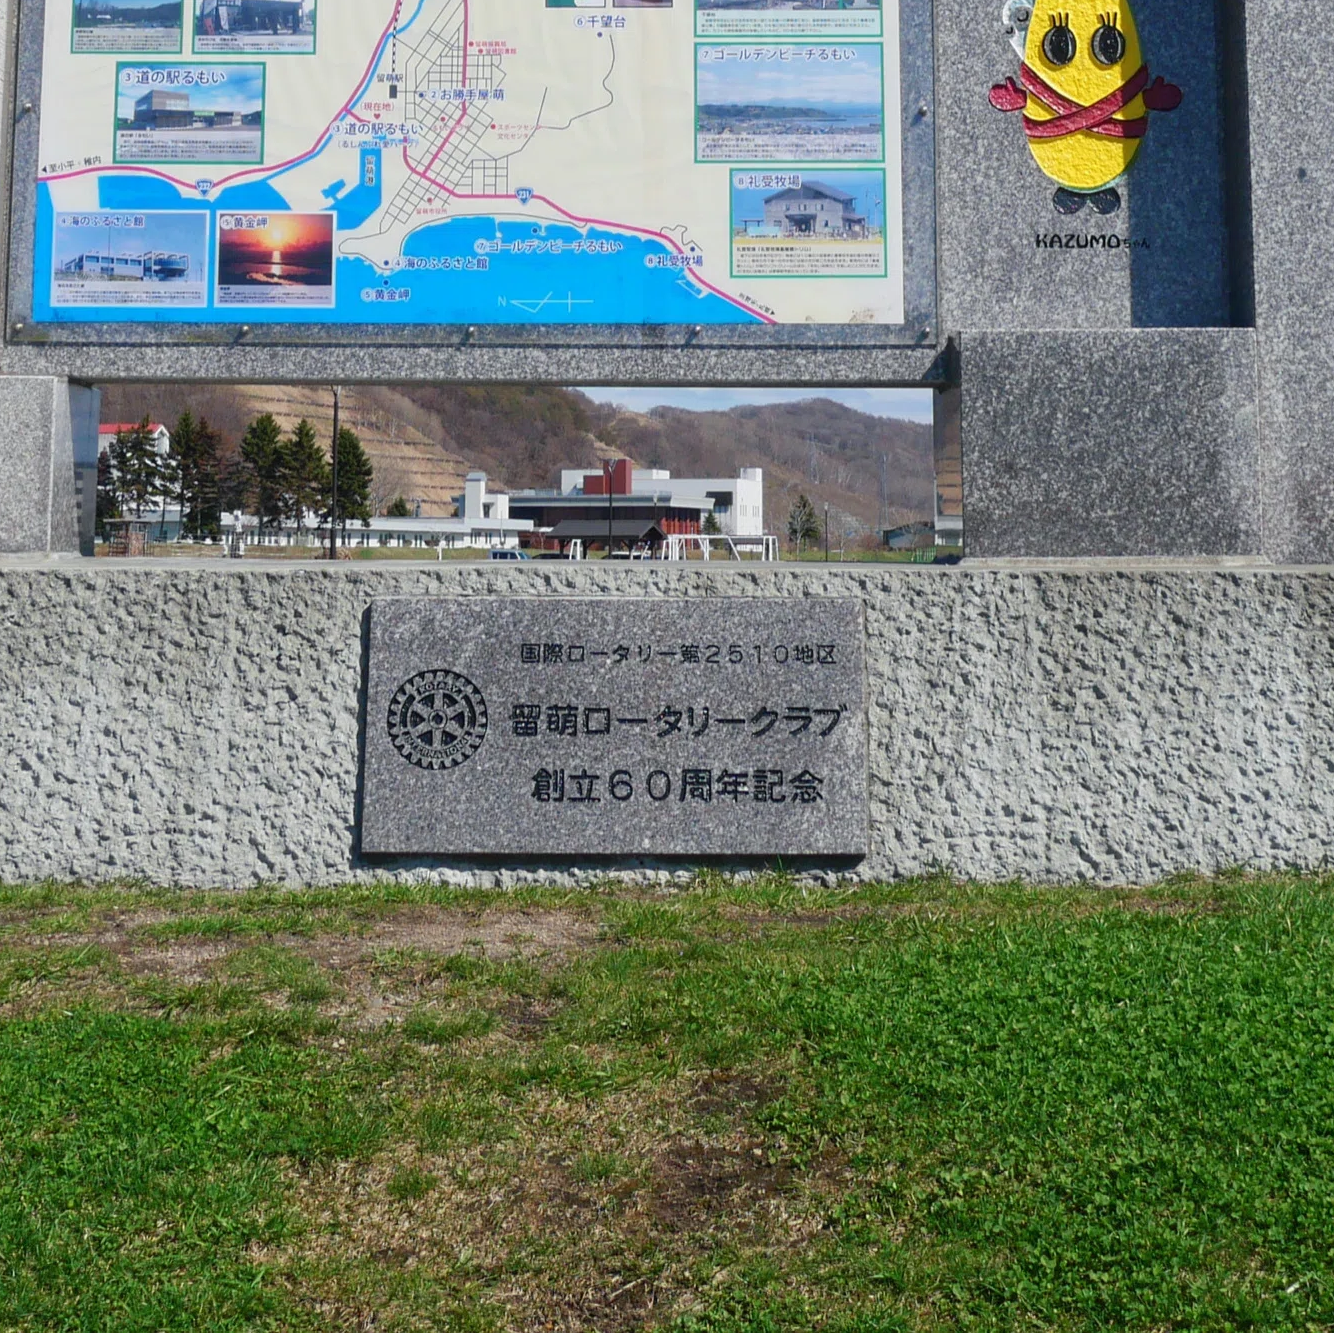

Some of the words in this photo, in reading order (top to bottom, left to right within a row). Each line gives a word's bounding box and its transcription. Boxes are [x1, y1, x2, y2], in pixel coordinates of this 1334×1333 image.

[376, 73, 404, 83] 留萌駅
[518, 189, 531, 199] 231
[497, 295, 507, 307] N
[519, 642, 839, 666] 国際ロータリー第2510地区
[509, 701, 849, 738] 留萌ロータリークラブ
[529, 768, 826, 804] 創立60周年記念
